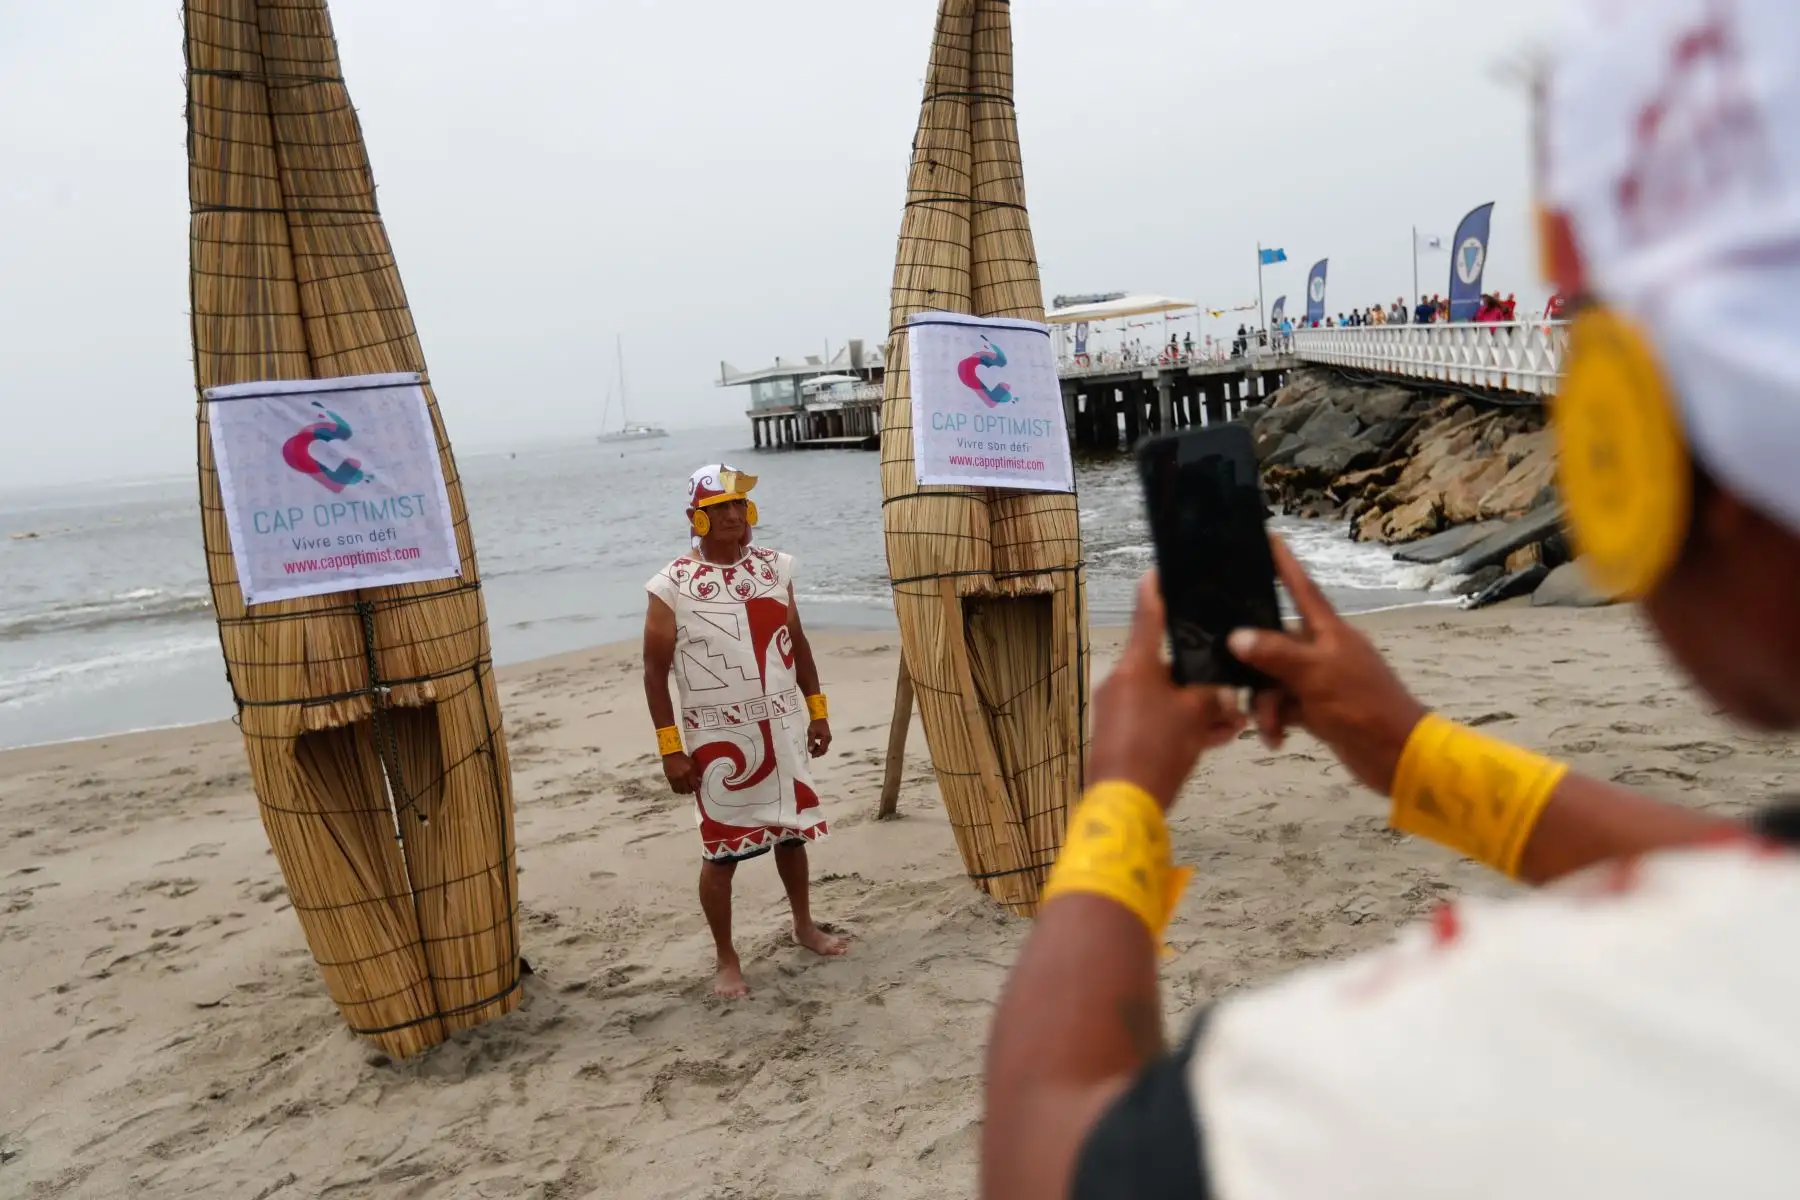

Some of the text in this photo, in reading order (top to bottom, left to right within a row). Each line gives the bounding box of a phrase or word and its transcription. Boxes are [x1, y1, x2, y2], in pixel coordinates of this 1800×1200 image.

[931, 412, 1053, 438] CAP OPTIMIST
[956, 437, 984, 450] Vivre
[987, 441, 1007, 451] son
[949, 455, 1045, 471] www.capoptimist.com
[253, 494, 426, 535] CAP OPTIMIST
[292, 527, 398, 551] Vivre son défi
[283, 546, 421, 575] www.capoptimist.com
